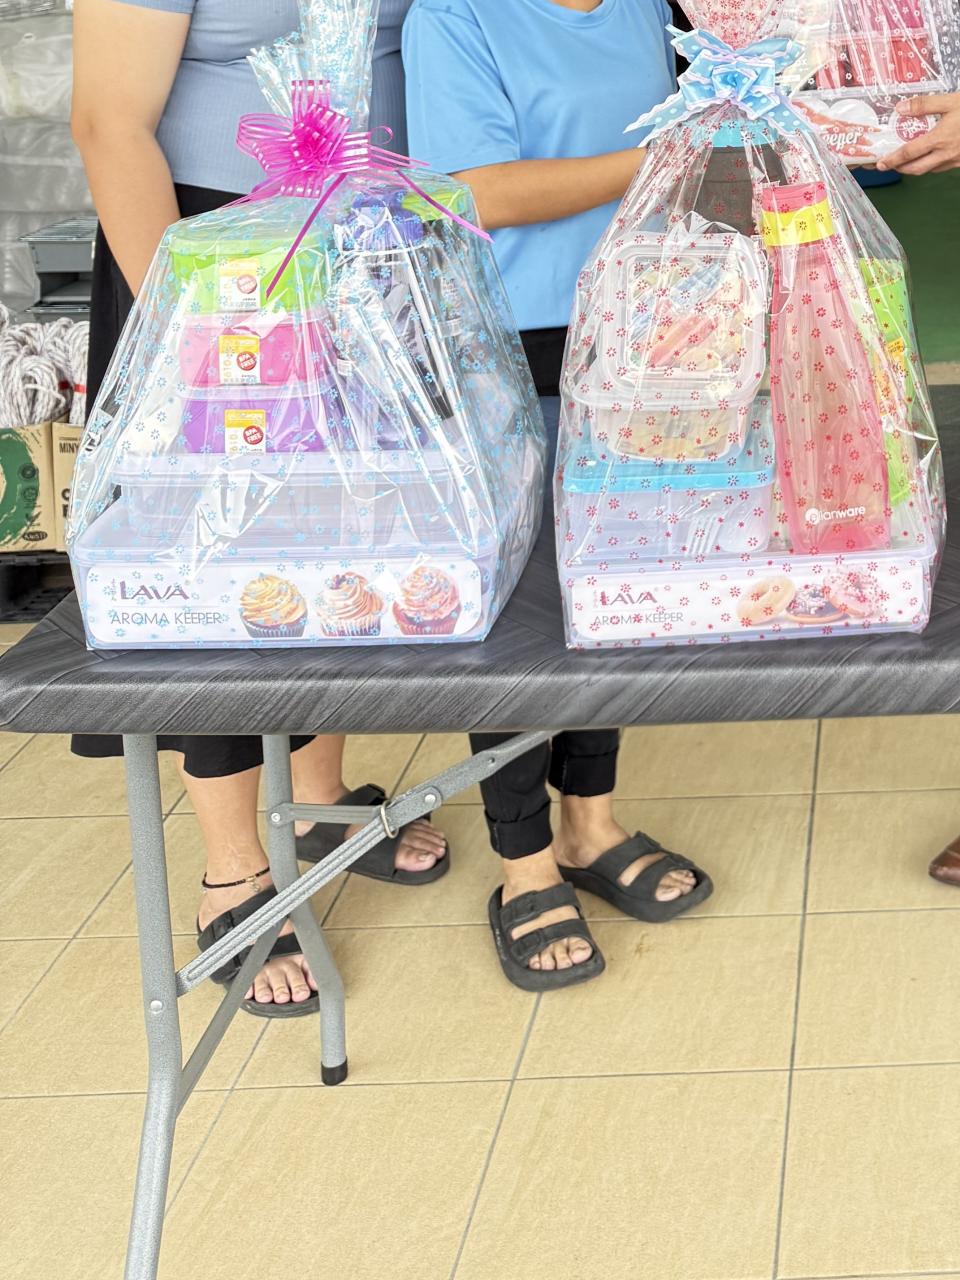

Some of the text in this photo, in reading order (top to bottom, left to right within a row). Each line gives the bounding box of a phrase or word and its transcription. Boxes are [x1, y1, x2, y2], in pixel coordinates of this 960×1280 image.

[119, 580, 190, 600] LAVA
[600, 590, 658, 606] LAVA
[111, 612, 223, 625] AROMA KEEPER
[645, 611, 684, 624] KEEPER
